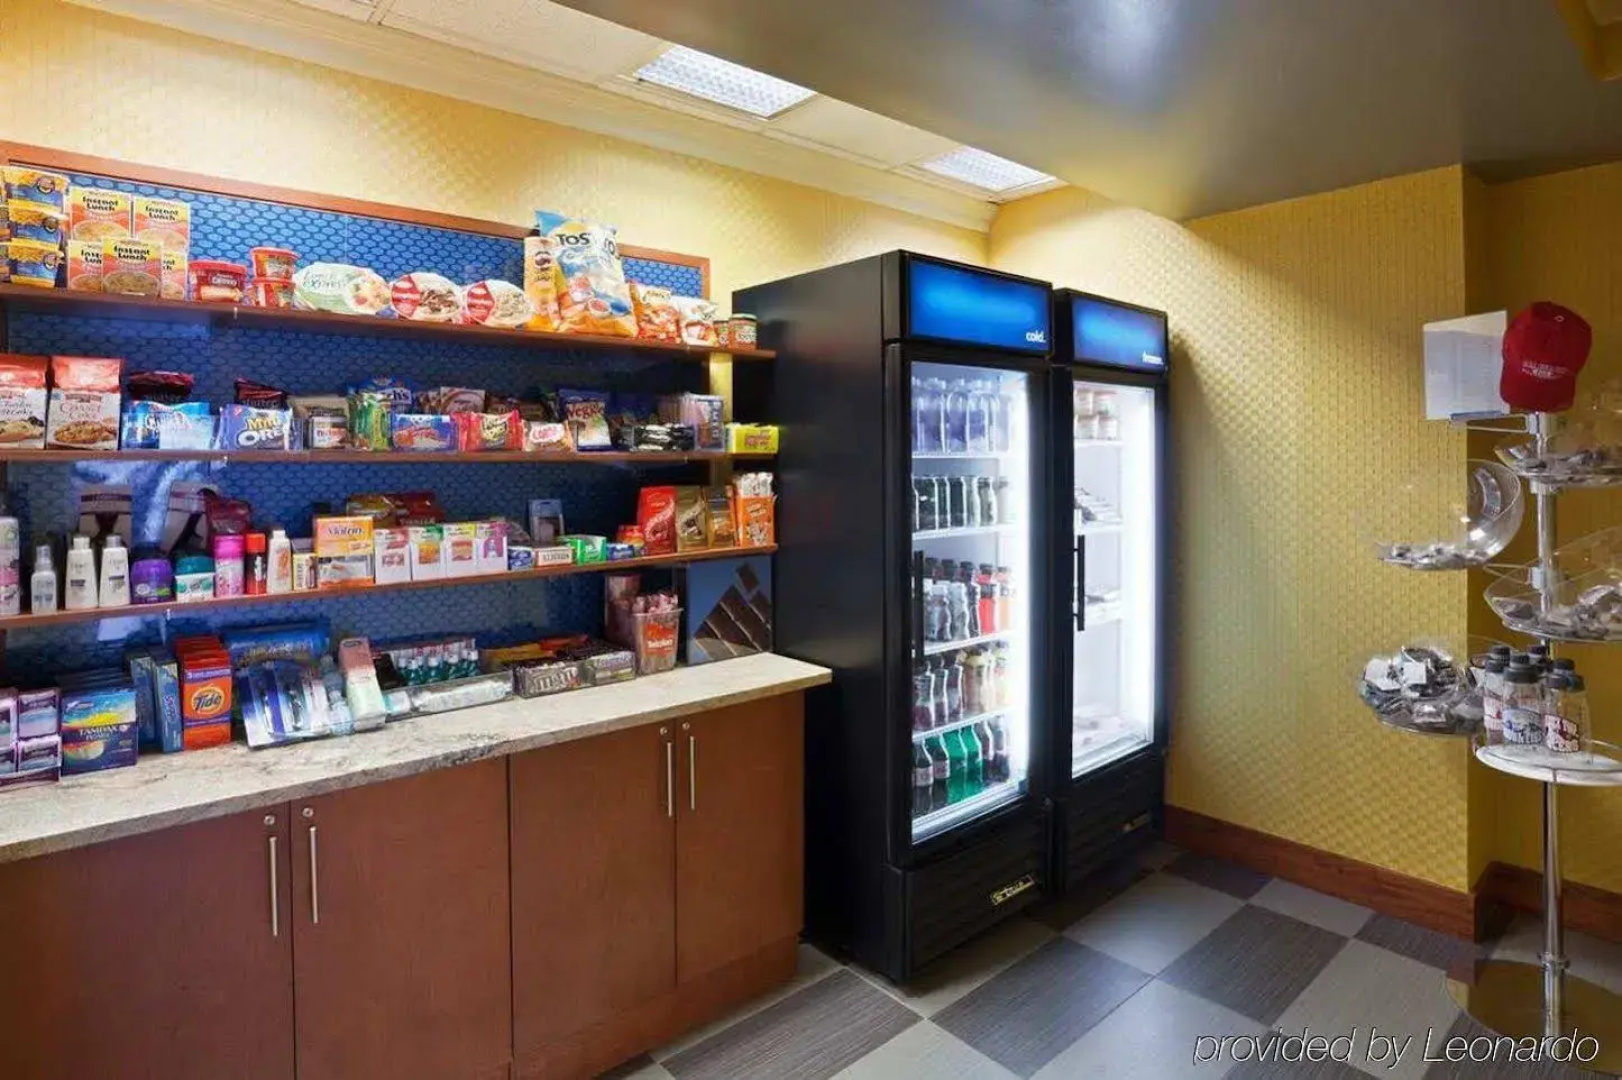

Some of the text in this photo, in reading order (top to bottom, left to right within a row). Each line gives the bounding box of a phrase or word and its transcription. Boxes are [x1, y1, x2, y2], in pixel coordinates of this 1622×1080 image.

[82, 196, 119, 207] Instant
[86, 203, 116, 212] Lunch
[145, 205, 179, 216] Instant
[148, 212, 176, 221] Lunch
[113, 245, 150, 256] Instant
[117, 253, 147, 262] Lunch
[193, 693, 223, 710] Tide
